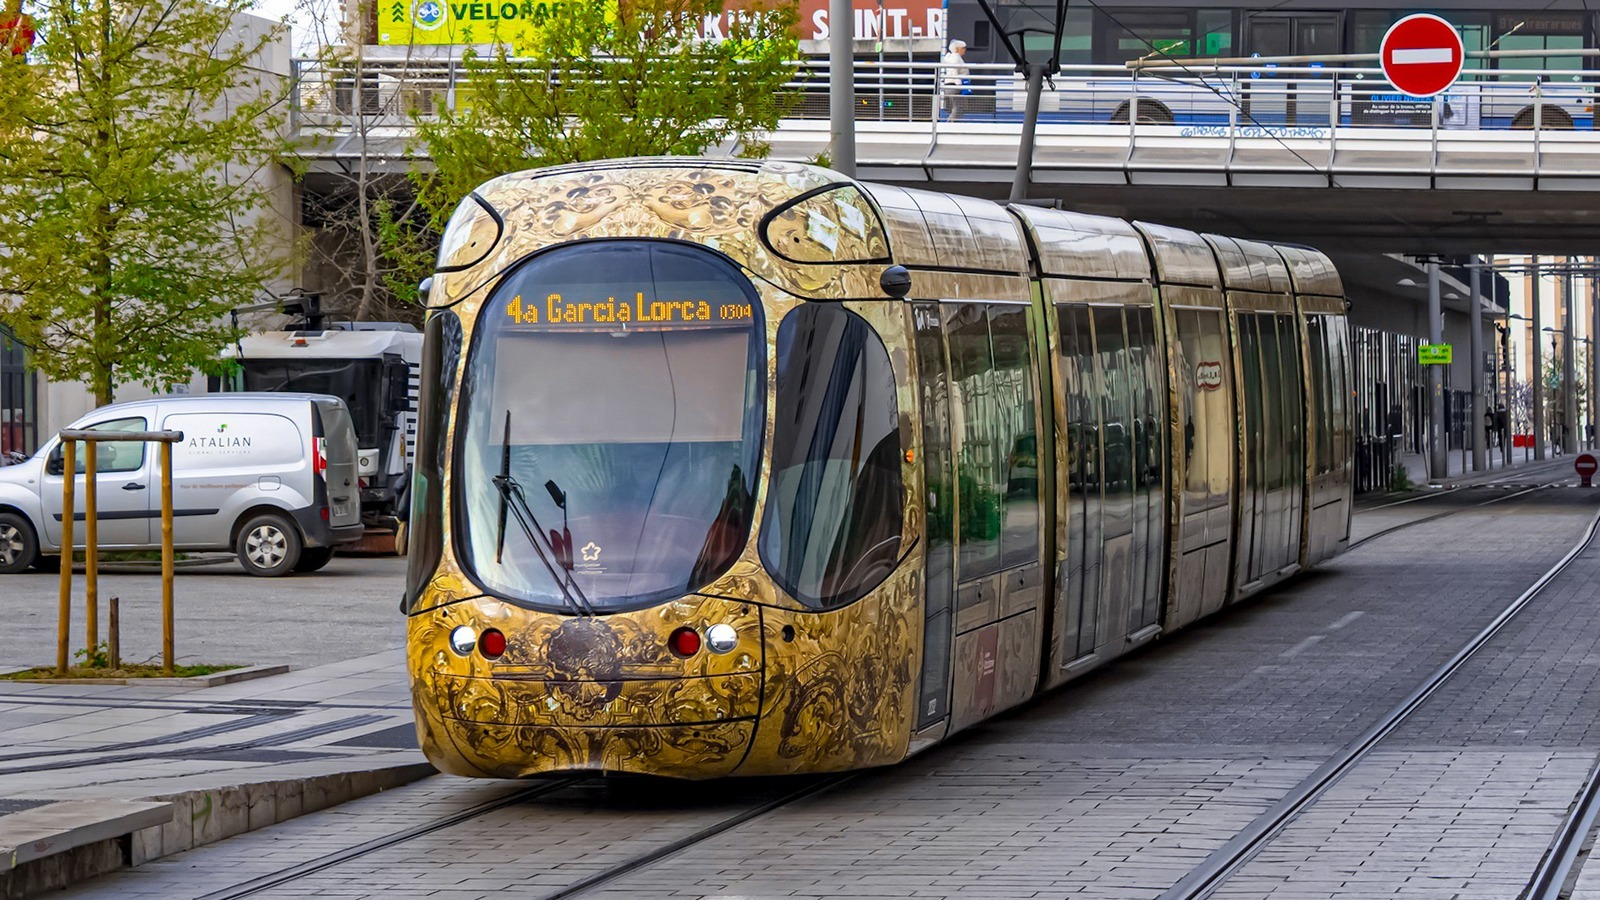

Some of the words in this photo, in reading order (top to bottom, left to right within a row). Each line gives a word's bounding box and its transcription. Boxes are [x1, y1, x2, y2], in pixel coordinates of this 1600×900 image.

[507, 294, 538, 323] 4a
[547, 293, 630, 323] Garcia
[636, 291, 710, 322] Lorca
[719, 303, 752, 321] 0304
[189, 437, 252, 448] ATALIAN
